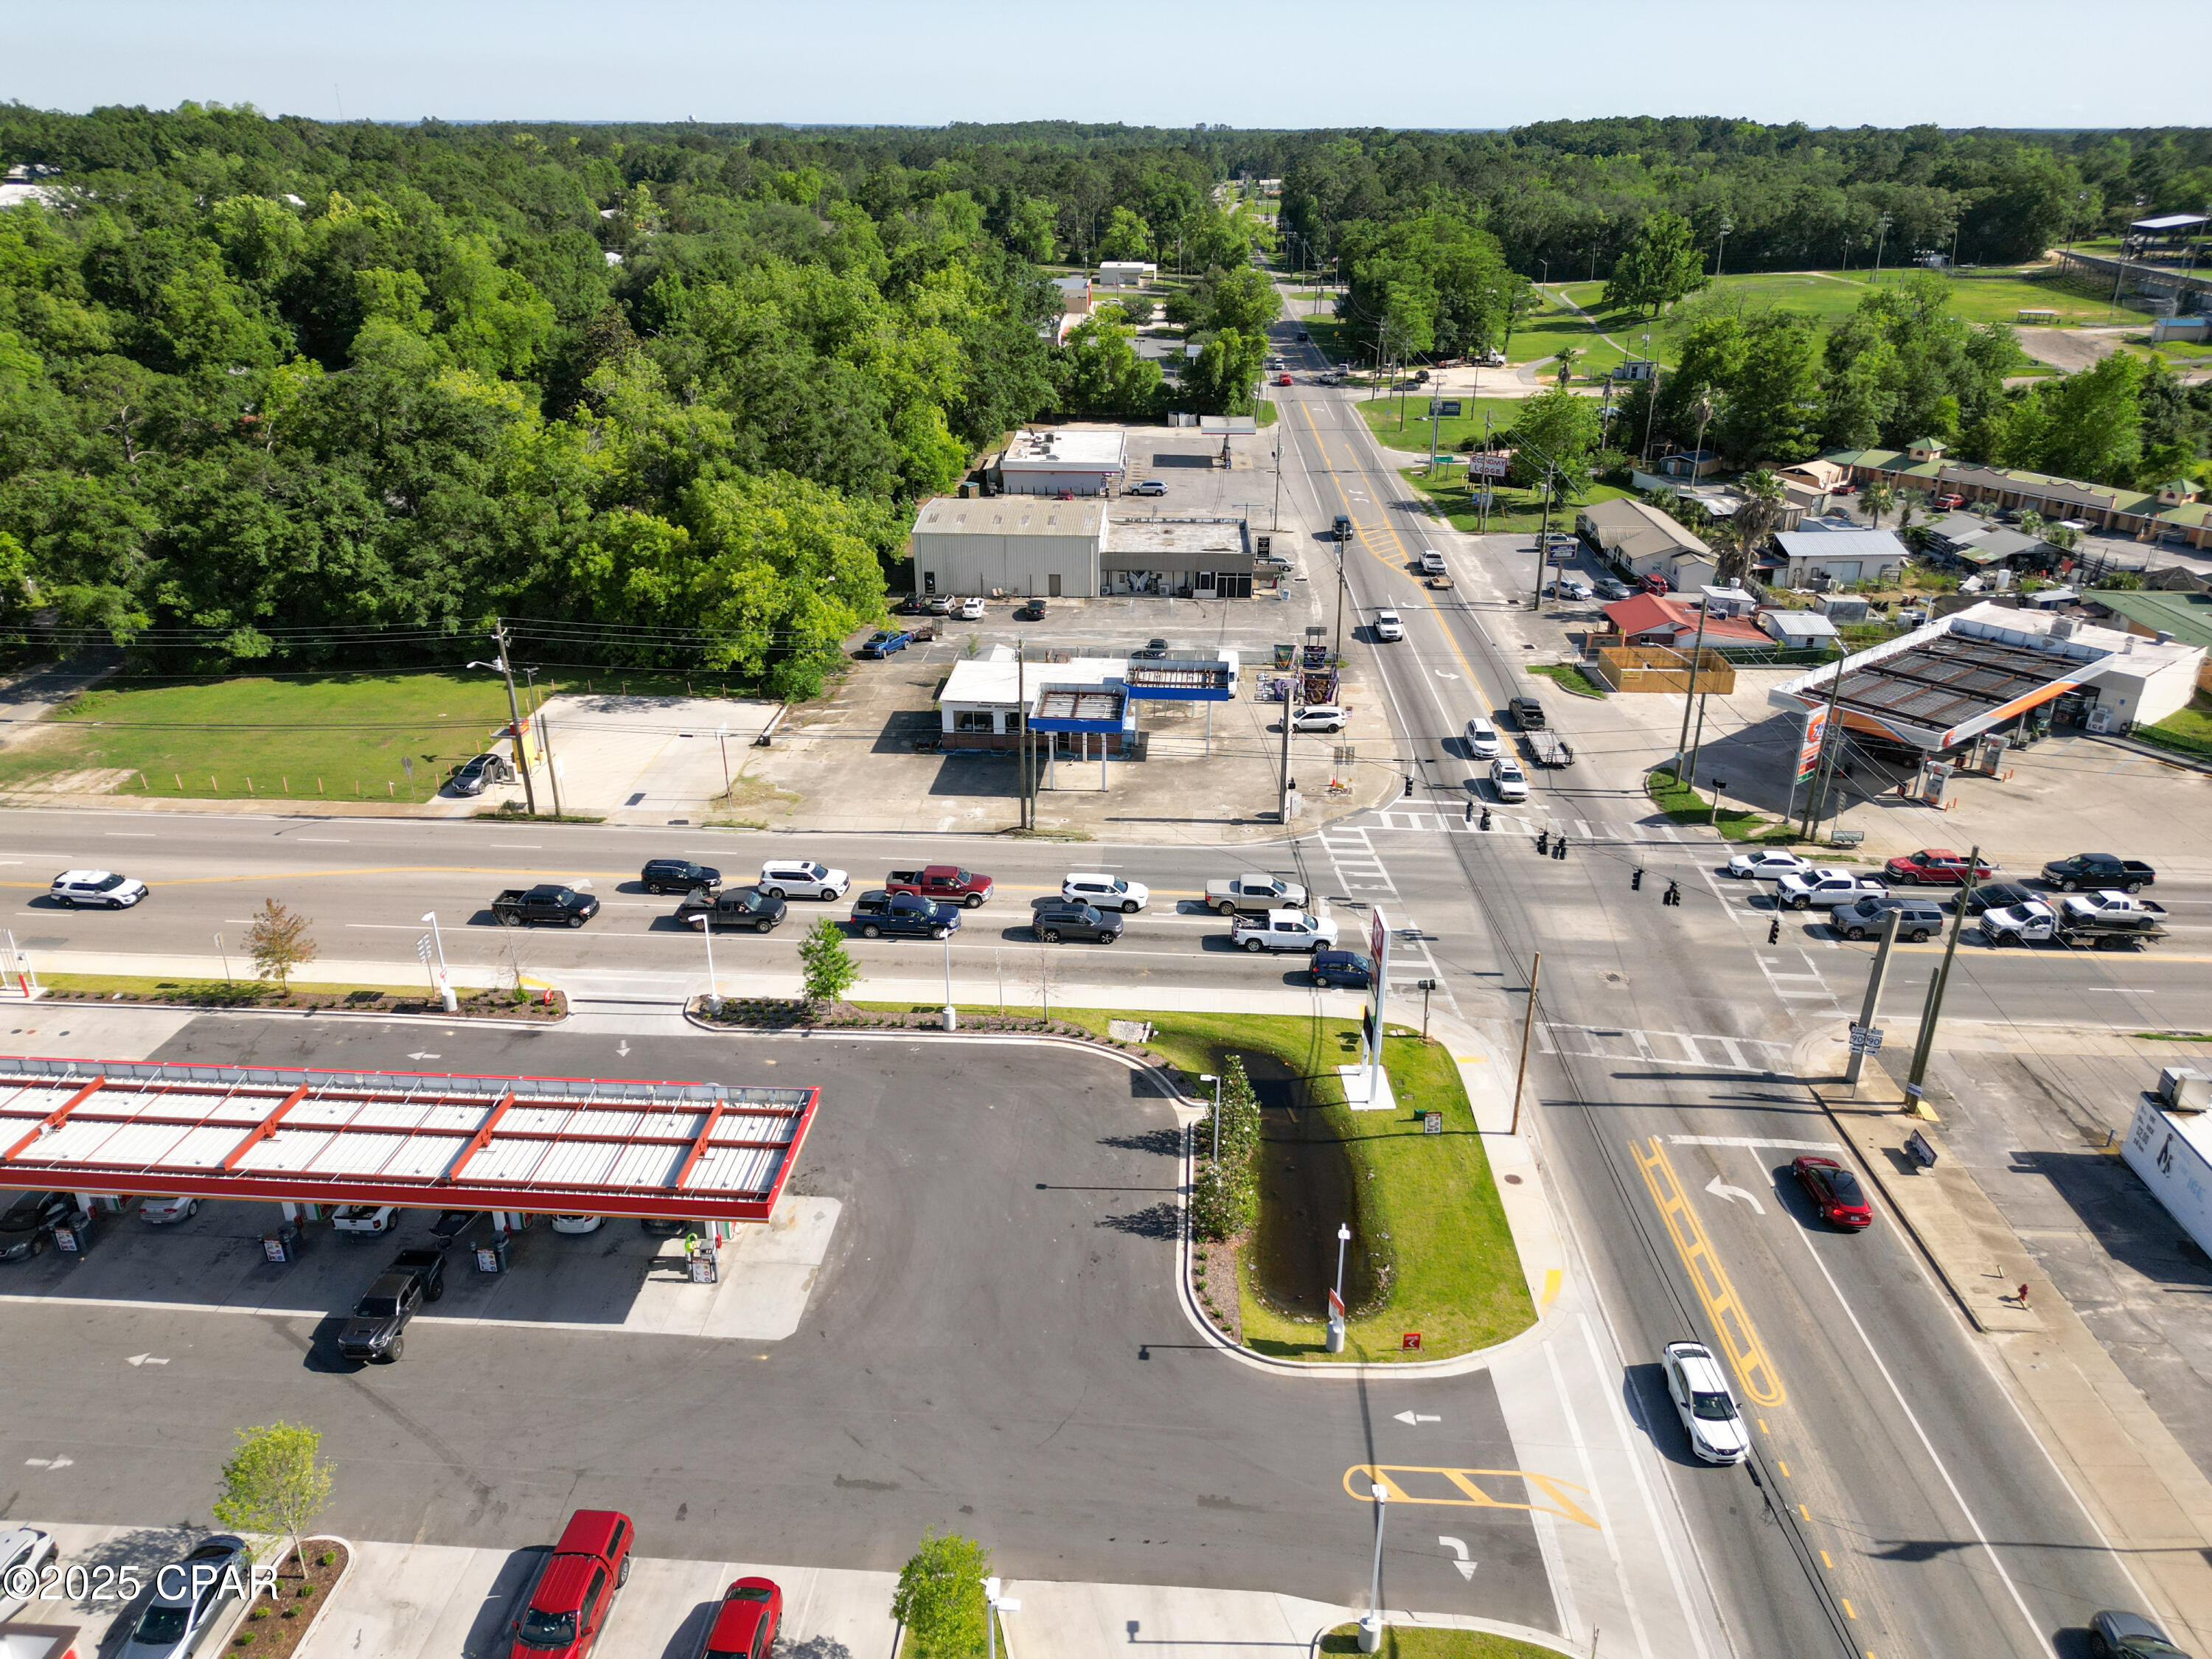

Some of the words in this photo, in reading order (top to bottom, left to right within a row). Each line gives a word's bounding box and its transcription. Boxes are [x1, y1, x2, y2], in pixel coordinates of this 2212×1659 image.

[1472, 456, 1506, 467] ECONOMY
[1475, 465, 1500, 474] LODGE
[1851, 1034, 1863, 1043] 90
[1868, 1037, 1880, 1046] 90
